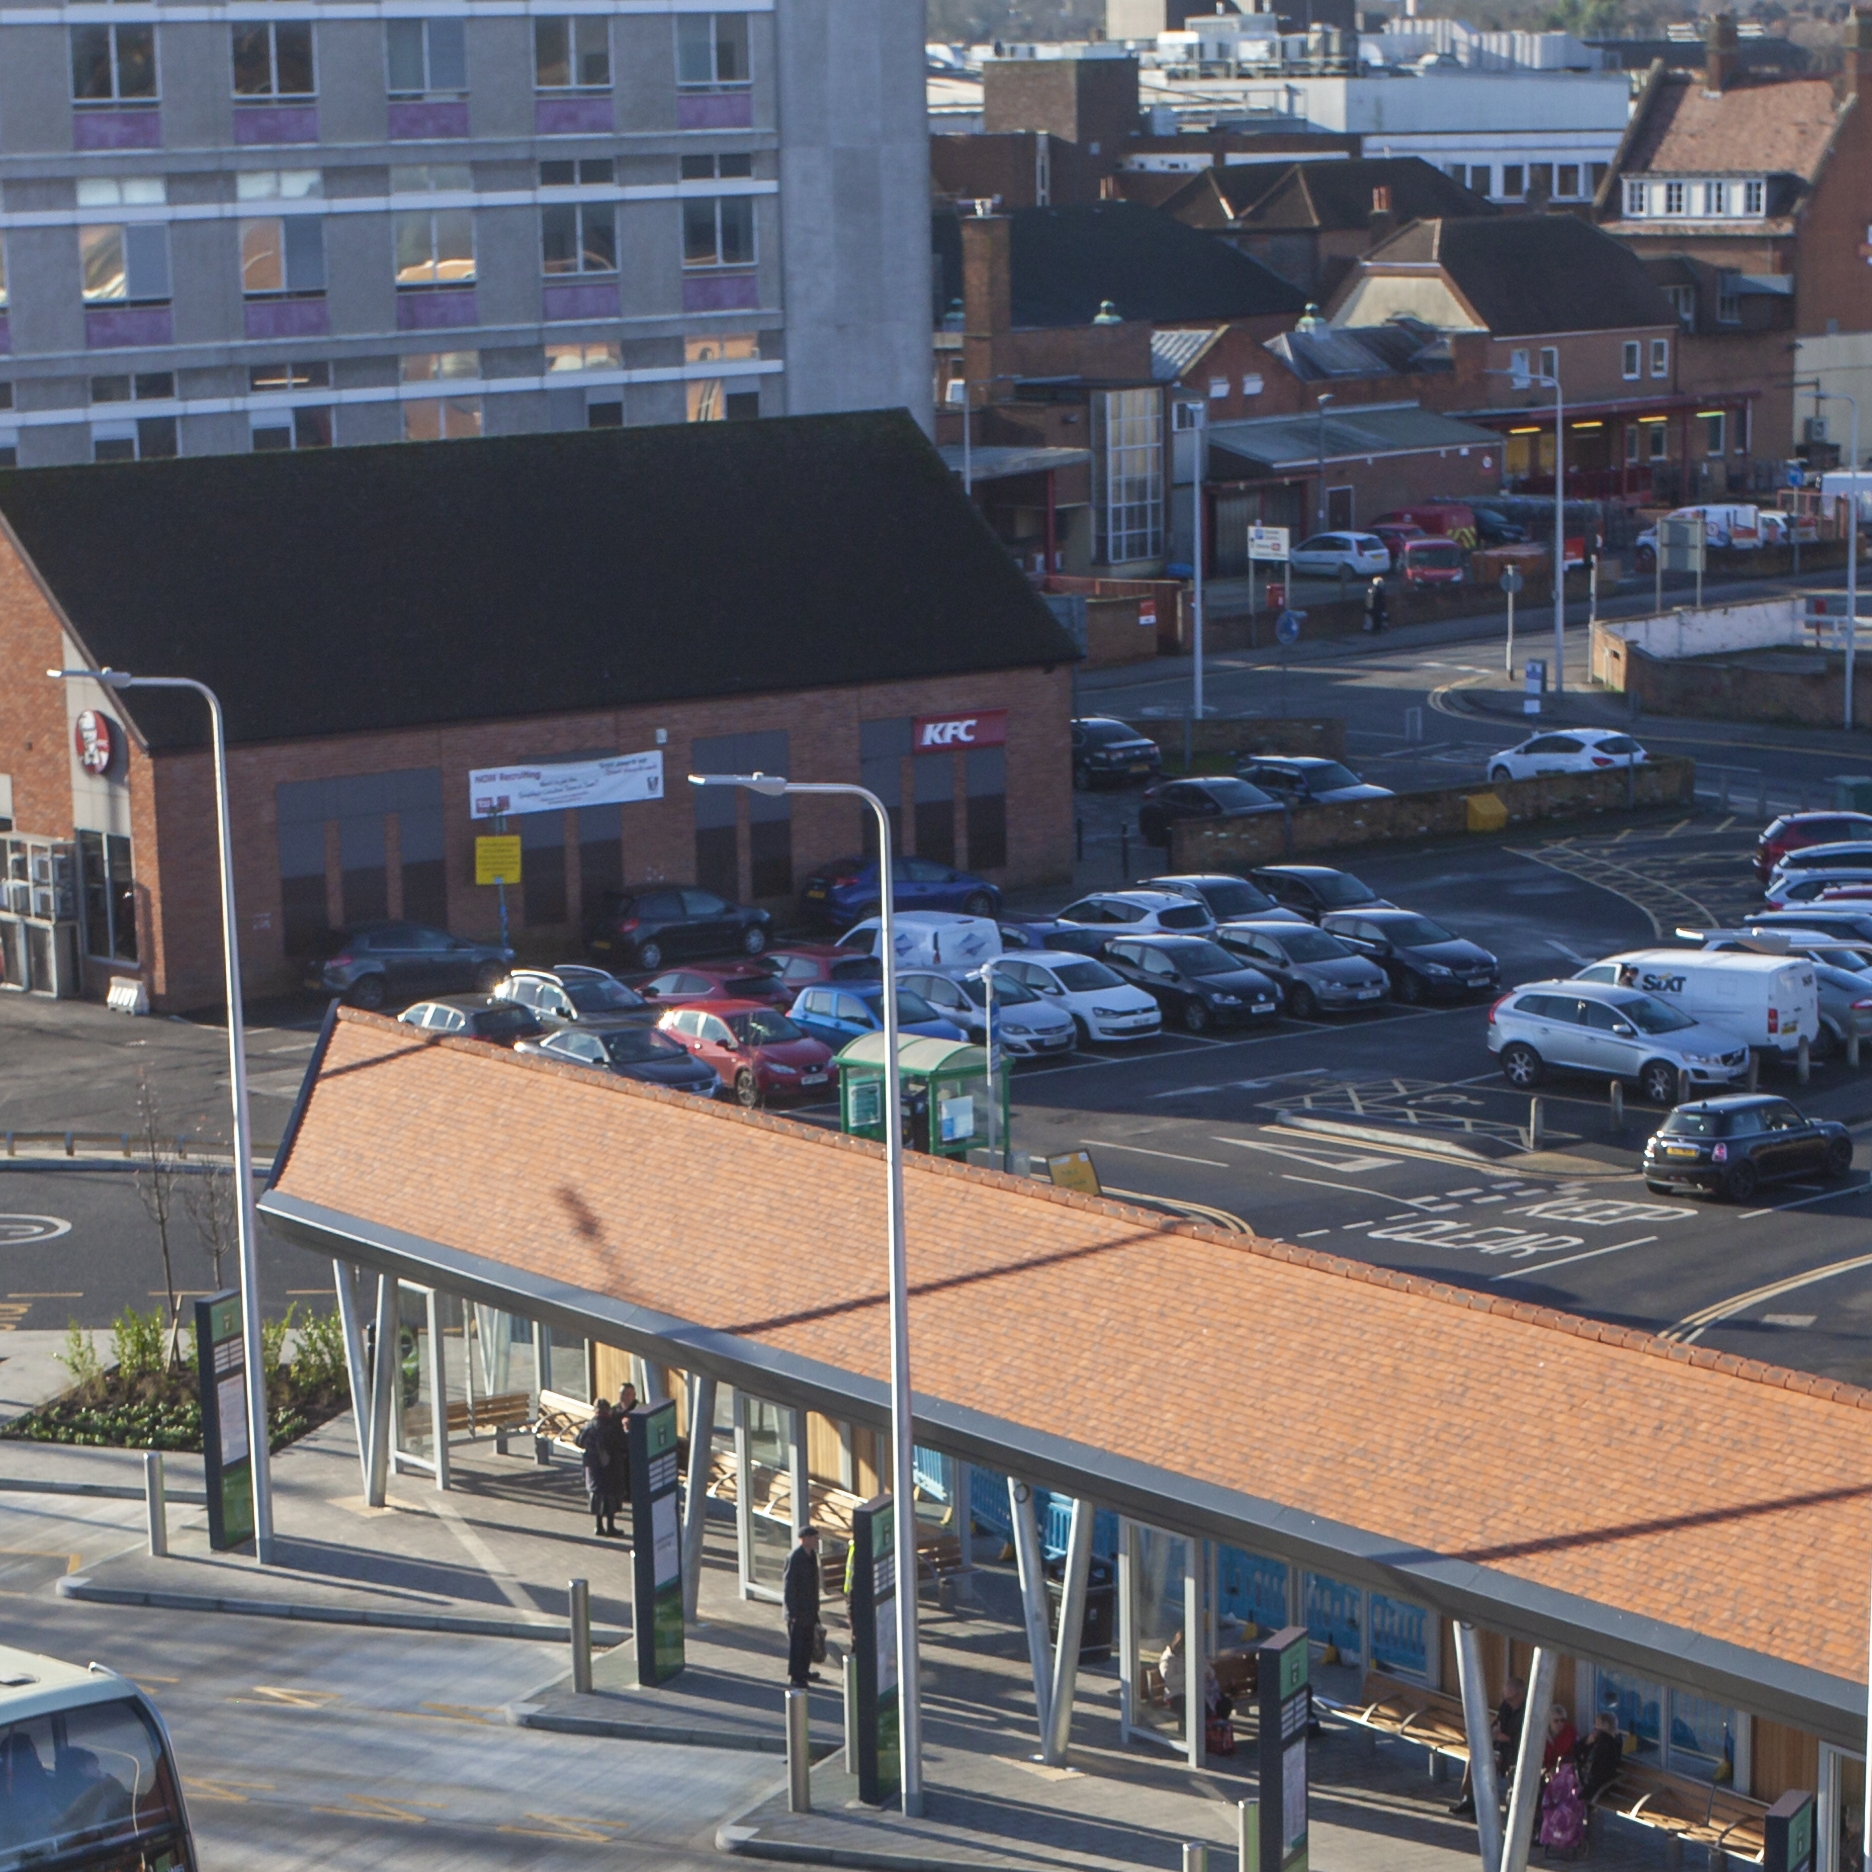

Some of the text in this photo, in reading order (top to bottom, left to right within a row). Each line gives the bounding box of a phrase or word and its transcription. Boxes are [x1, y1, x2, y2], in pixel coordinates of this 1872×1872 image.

[920, 719, 978, 746] KFC
[1503, 1196, 1700, 1227] KEEP
[1367, 1219, 1585, 1260] CLEAR
